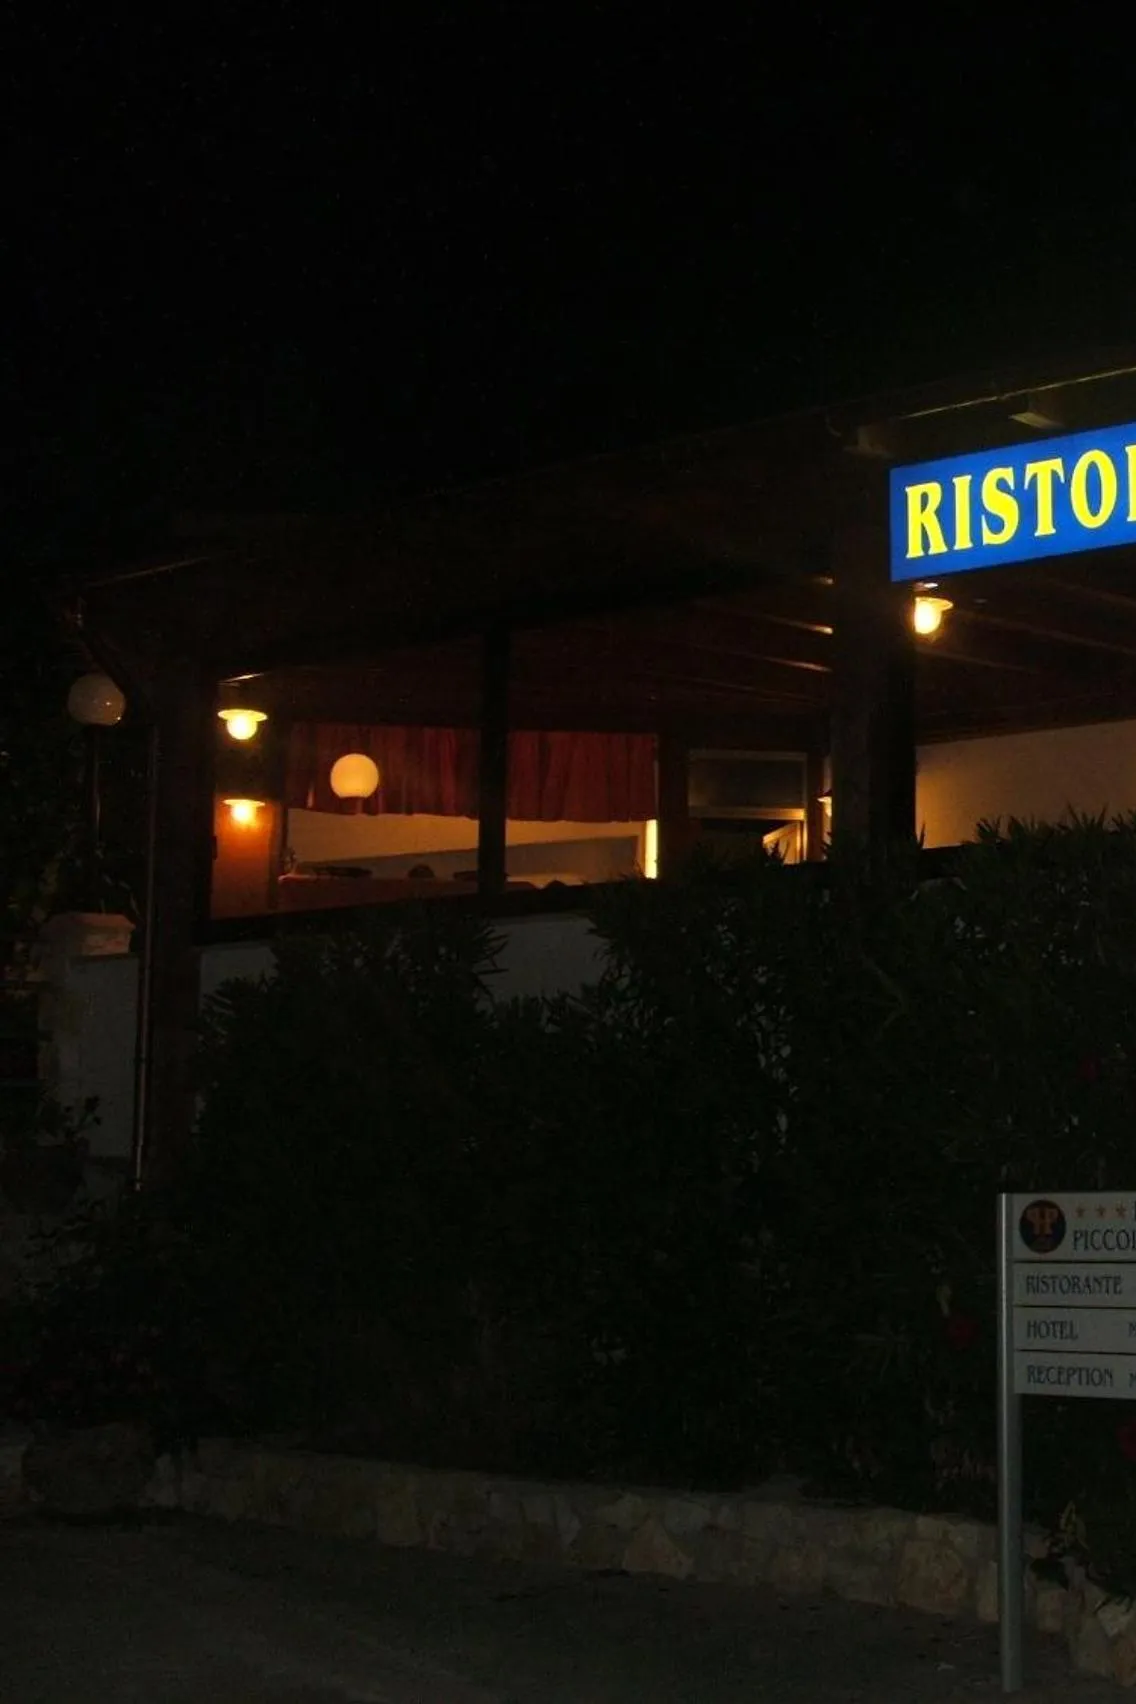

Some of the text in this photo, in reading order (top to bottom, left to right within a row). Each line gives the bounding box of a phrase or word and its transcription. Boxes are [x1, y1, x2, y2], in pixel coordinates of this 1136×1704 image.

[1026, 1275, 1123, 1295] RISTORANTE
[1026, 1320, 1079, 1340] HOTEL
[1026, 1364, 1113, 1387] RECEPTION
